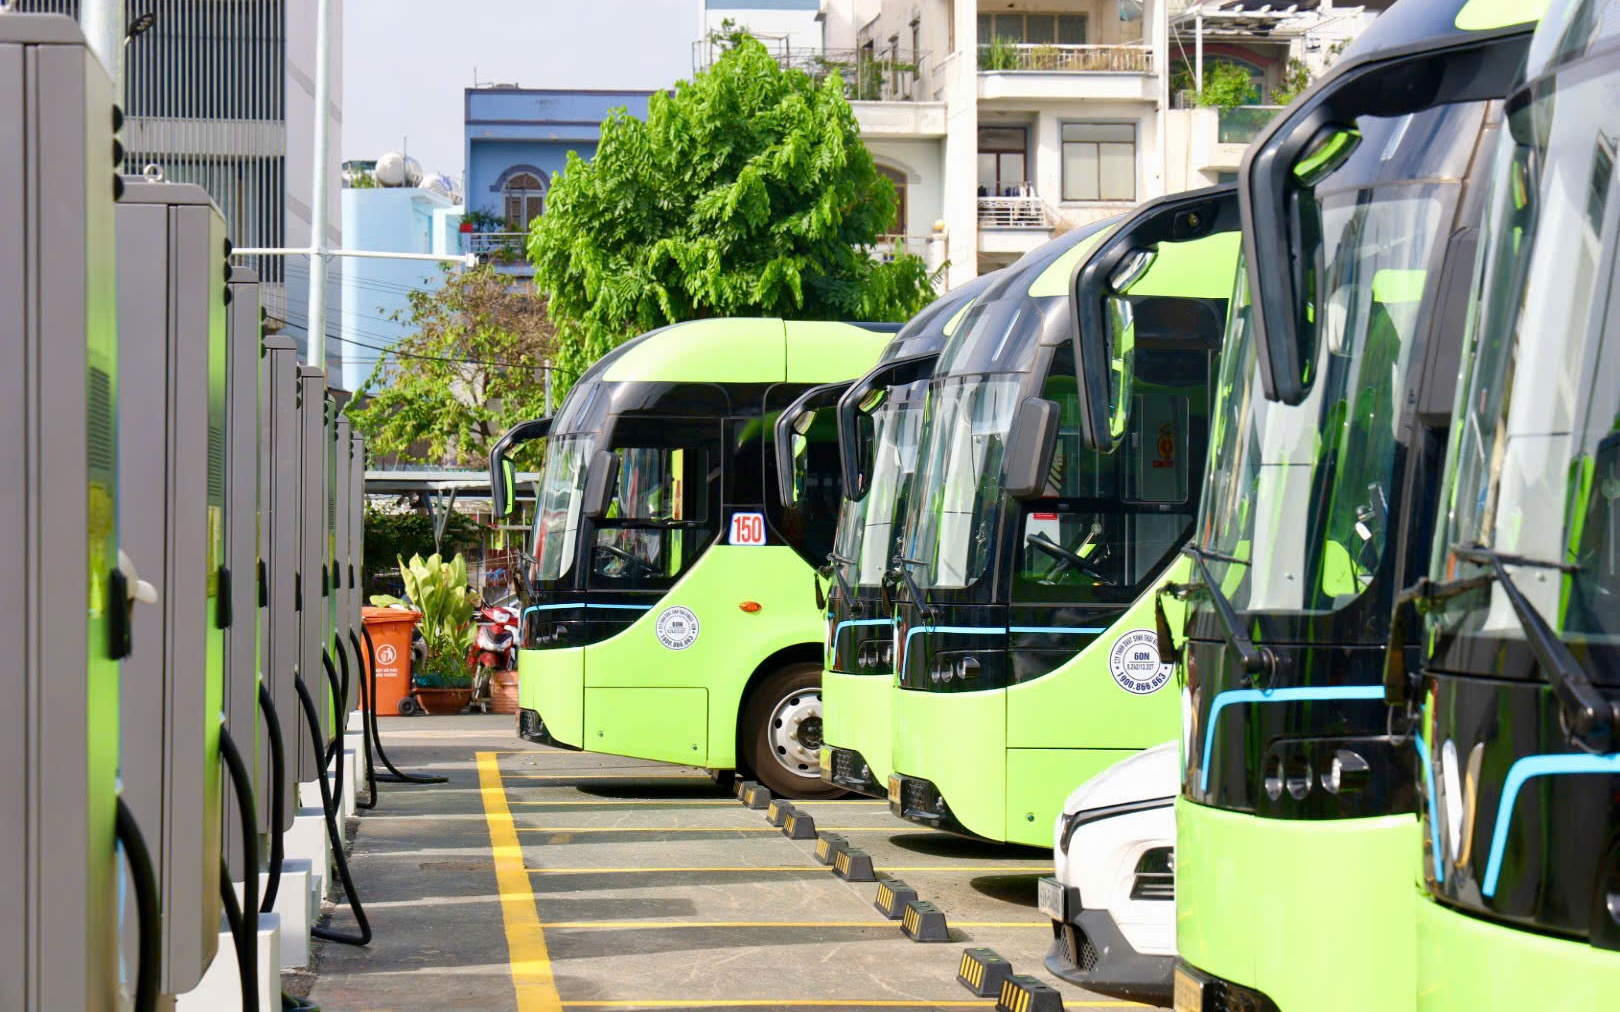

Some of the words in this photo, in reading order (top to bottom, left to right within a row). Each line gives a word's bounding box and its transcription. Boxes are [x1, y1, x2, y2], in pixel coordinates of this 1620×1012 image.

[734, 516, 762, 543] 150
[1134, 652, 1150, 660] 60N
[1117, 672, 1166, 690] 1900.866.663
